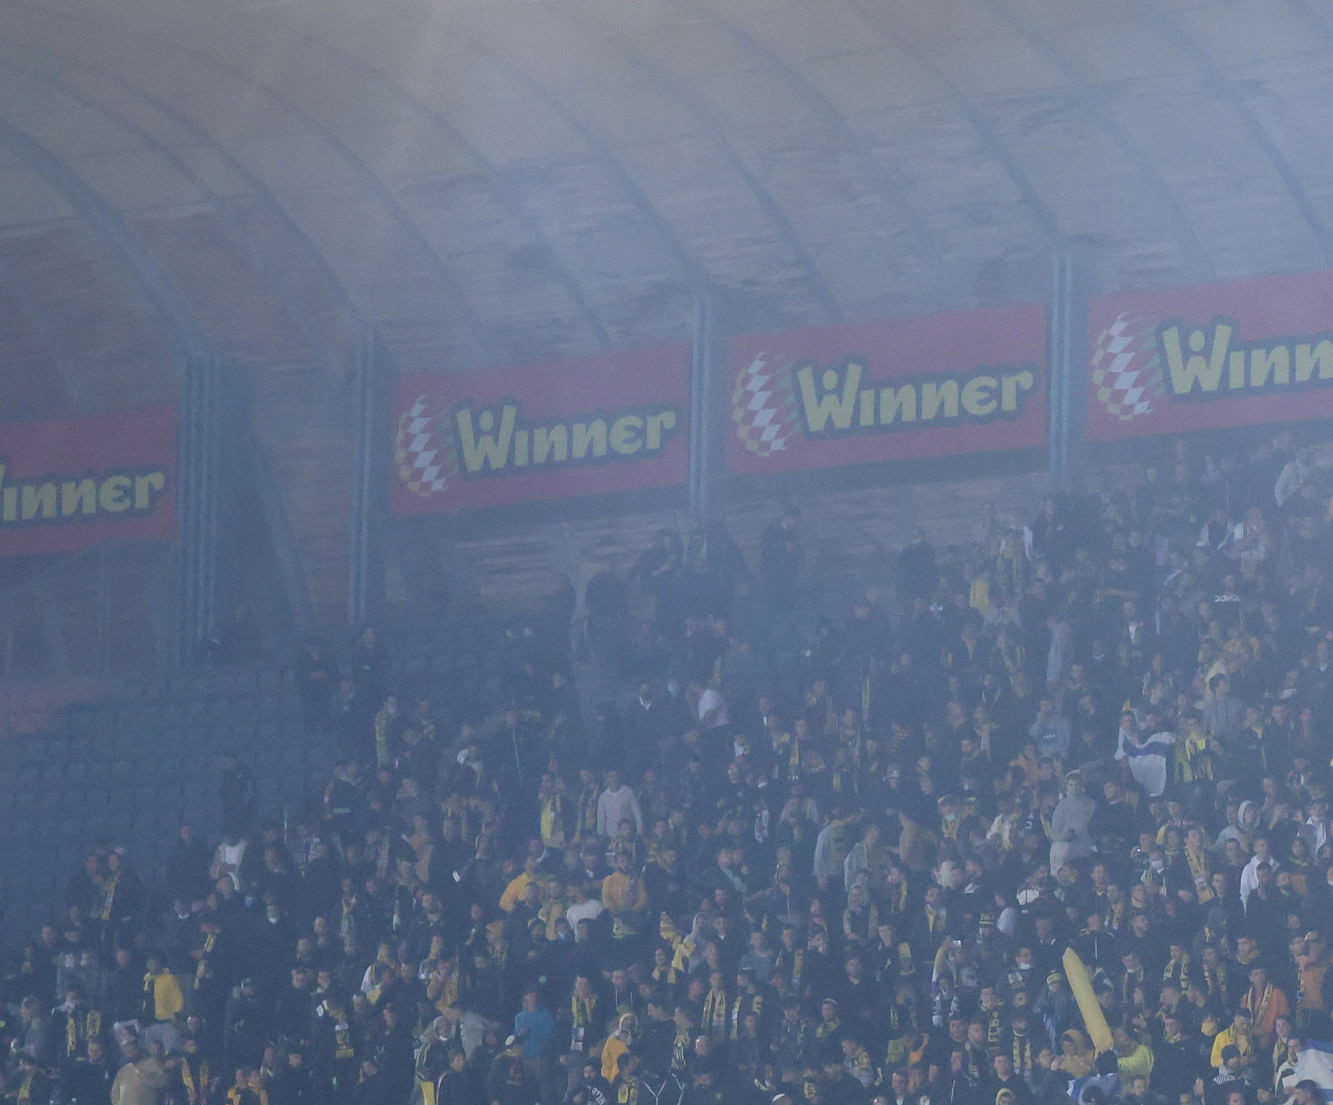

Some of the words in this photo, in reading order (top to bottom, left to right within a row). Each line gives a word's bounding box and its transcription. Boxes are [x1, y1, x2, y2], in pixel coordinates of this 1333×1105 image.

[797, 363, 1034, 433] Winner
[455, 404, 677, 472] Winner
[0, 465, 166, 521] inner
